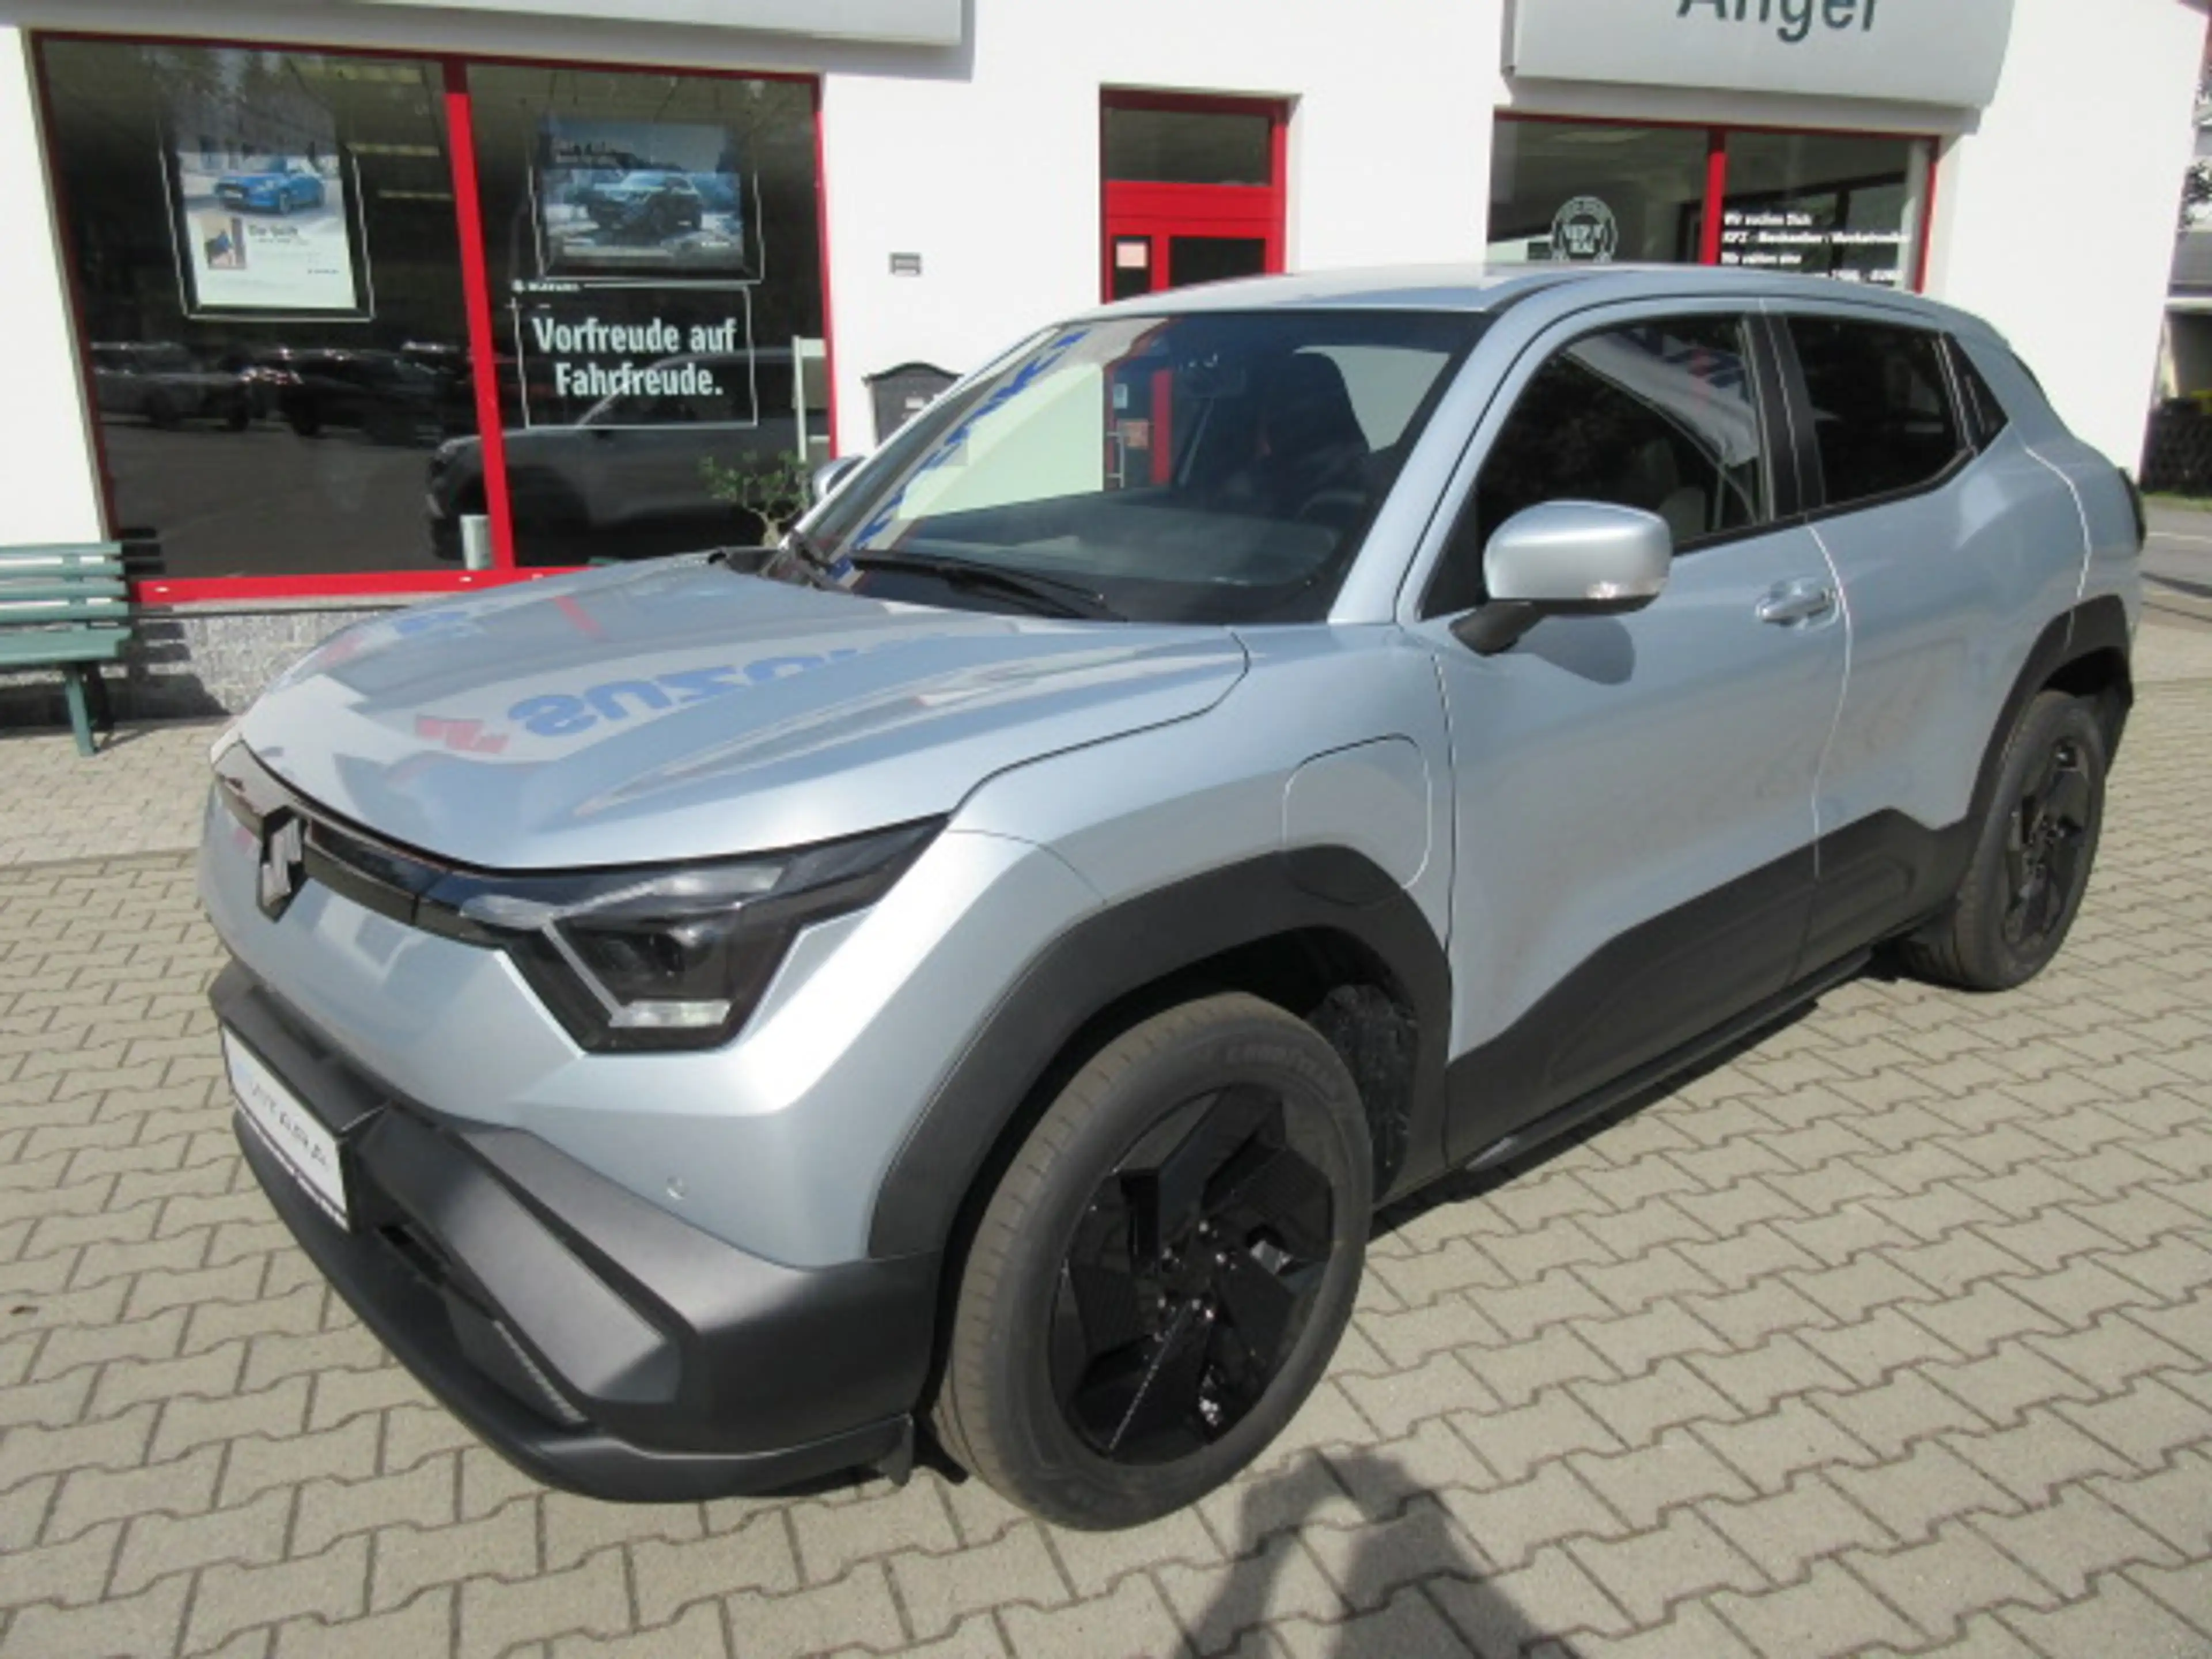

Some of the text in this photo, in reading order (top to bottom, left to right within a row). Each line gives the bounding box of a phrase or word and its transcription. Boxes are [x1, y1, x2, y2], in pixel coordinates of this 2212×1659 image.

[532, 317, 737, 353] Vorfreude auf
[555, 362, 724, 396] Fahrfreude.
